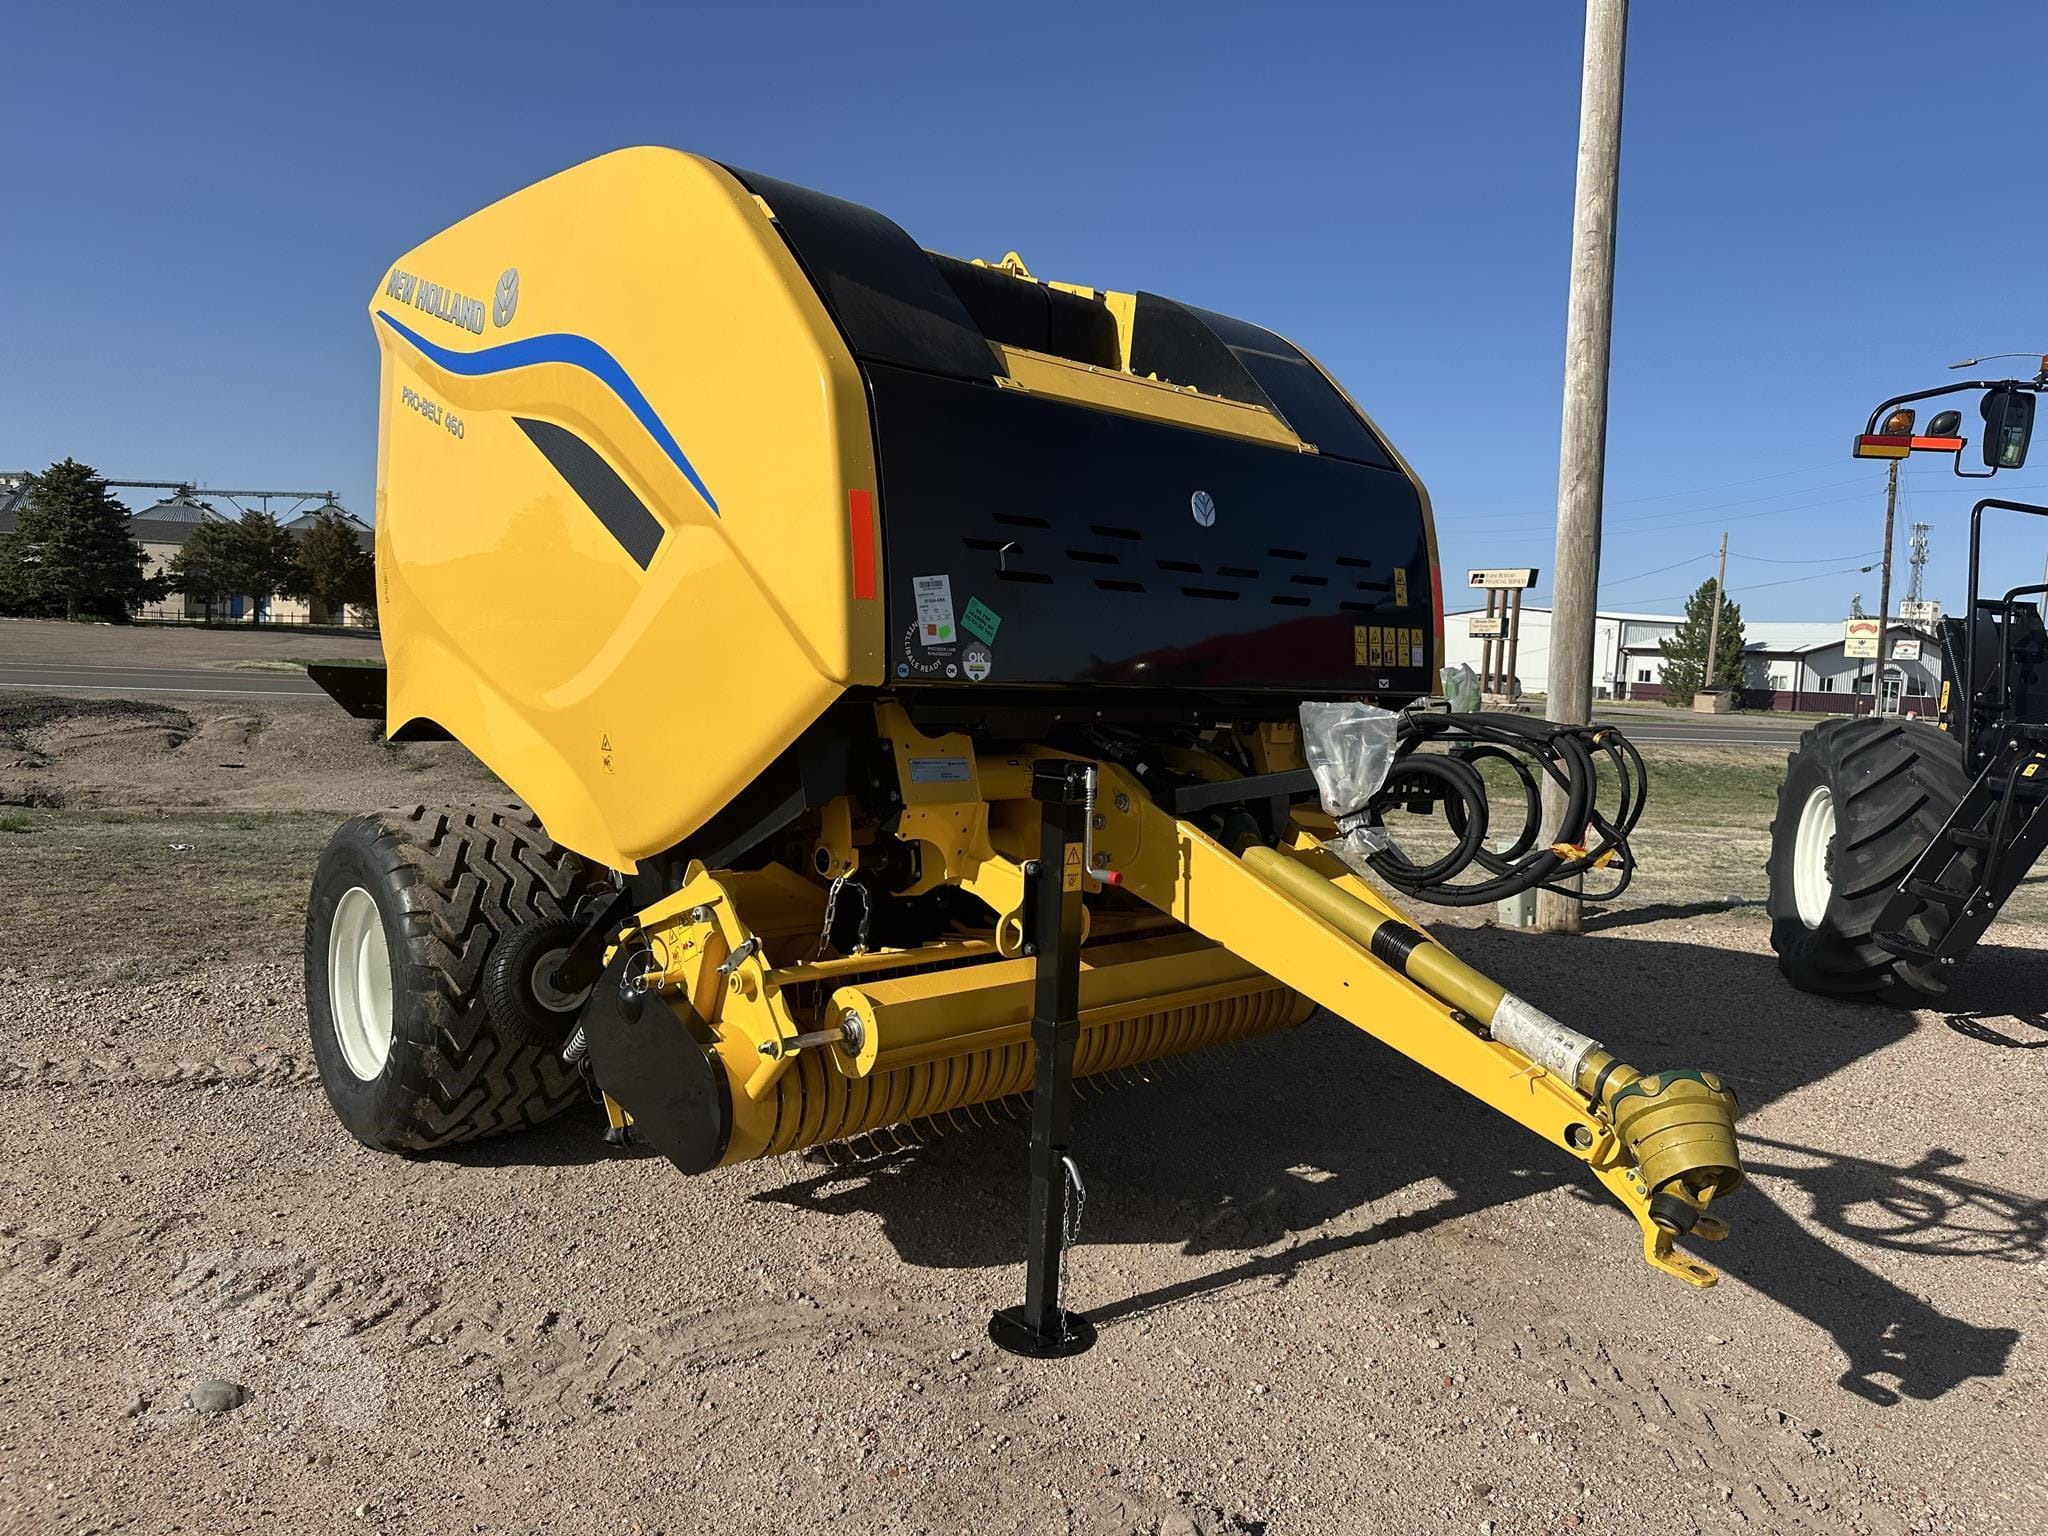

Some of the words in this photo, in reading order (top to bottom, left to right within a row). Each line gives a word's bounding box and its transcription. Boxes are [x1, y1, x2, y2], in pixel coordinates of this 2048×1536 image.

[386, 269, 418, 305] NEW
[415, 279, 486, 335] HOLLAND
[402, 385, 443, 426] PRO-BELT
[445, 411, 465, 440] 460
[920, 658, 942, 673] READY
[969, 652, 985, 663] OK
